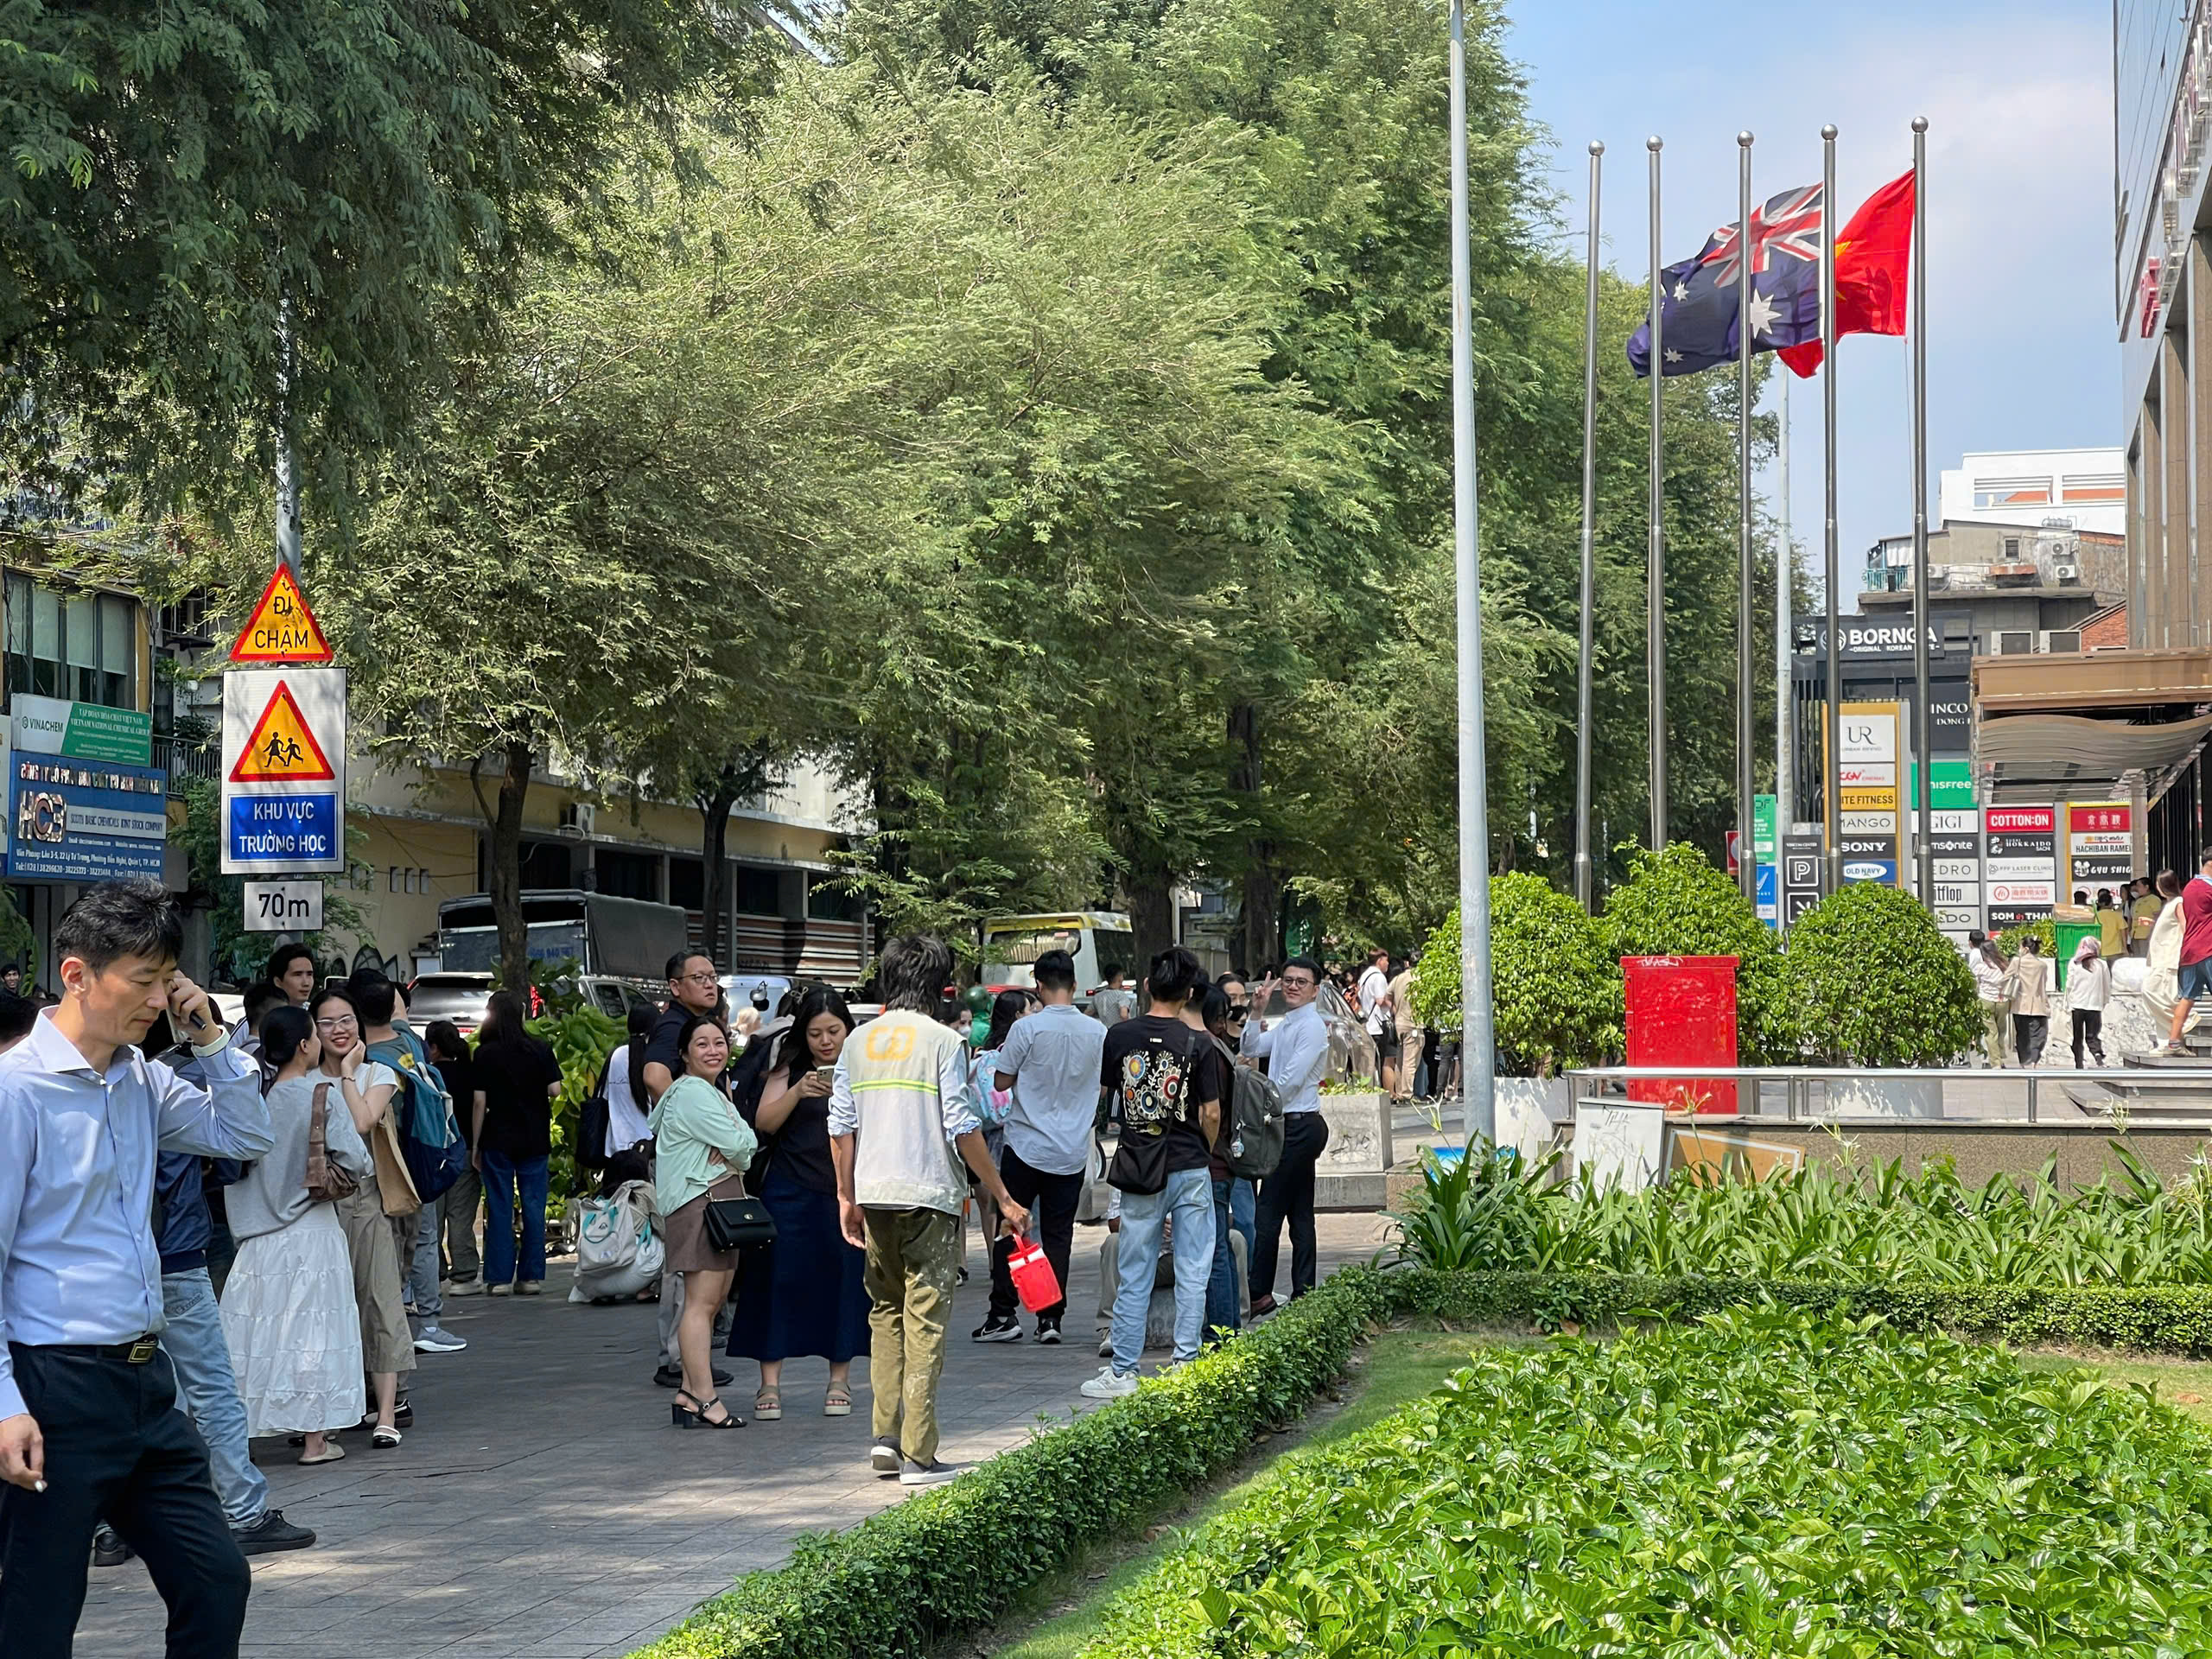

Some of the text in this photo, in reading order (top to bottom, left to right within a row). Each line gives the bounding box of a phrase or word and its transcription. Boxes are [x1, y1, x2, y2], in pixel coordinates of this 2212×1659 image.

[273, 596, 291, 614] ĐI
[255, 624, 308, 652] CHẬM
[1849, 626, 1938, 645] BORNGA
[1931, 702, 1969, 714] INCO
[29, 718, 63, 733] VINACHEM
[71, 718, 92, 728] VIETNAM
[1848, 727, 1877, 745] UR
[1840, 771, 1862, 780] CGV
[1841, 795, 1893, 804] ITE FITNESS
[254, 801, 315, 823] KHU VỰC
[238, 829, 327, 856] TRƯỜNG HỌC
[1841, 842, 1886, 852] SONY
[1931, 842, 1974, 851] msonite
[1795, 861, 1810, 881] P
[2090, 866, 2107, 874] GYU
[1934, 886, 1962, 901] itflop
[258, 893, 309, 918] 70m
